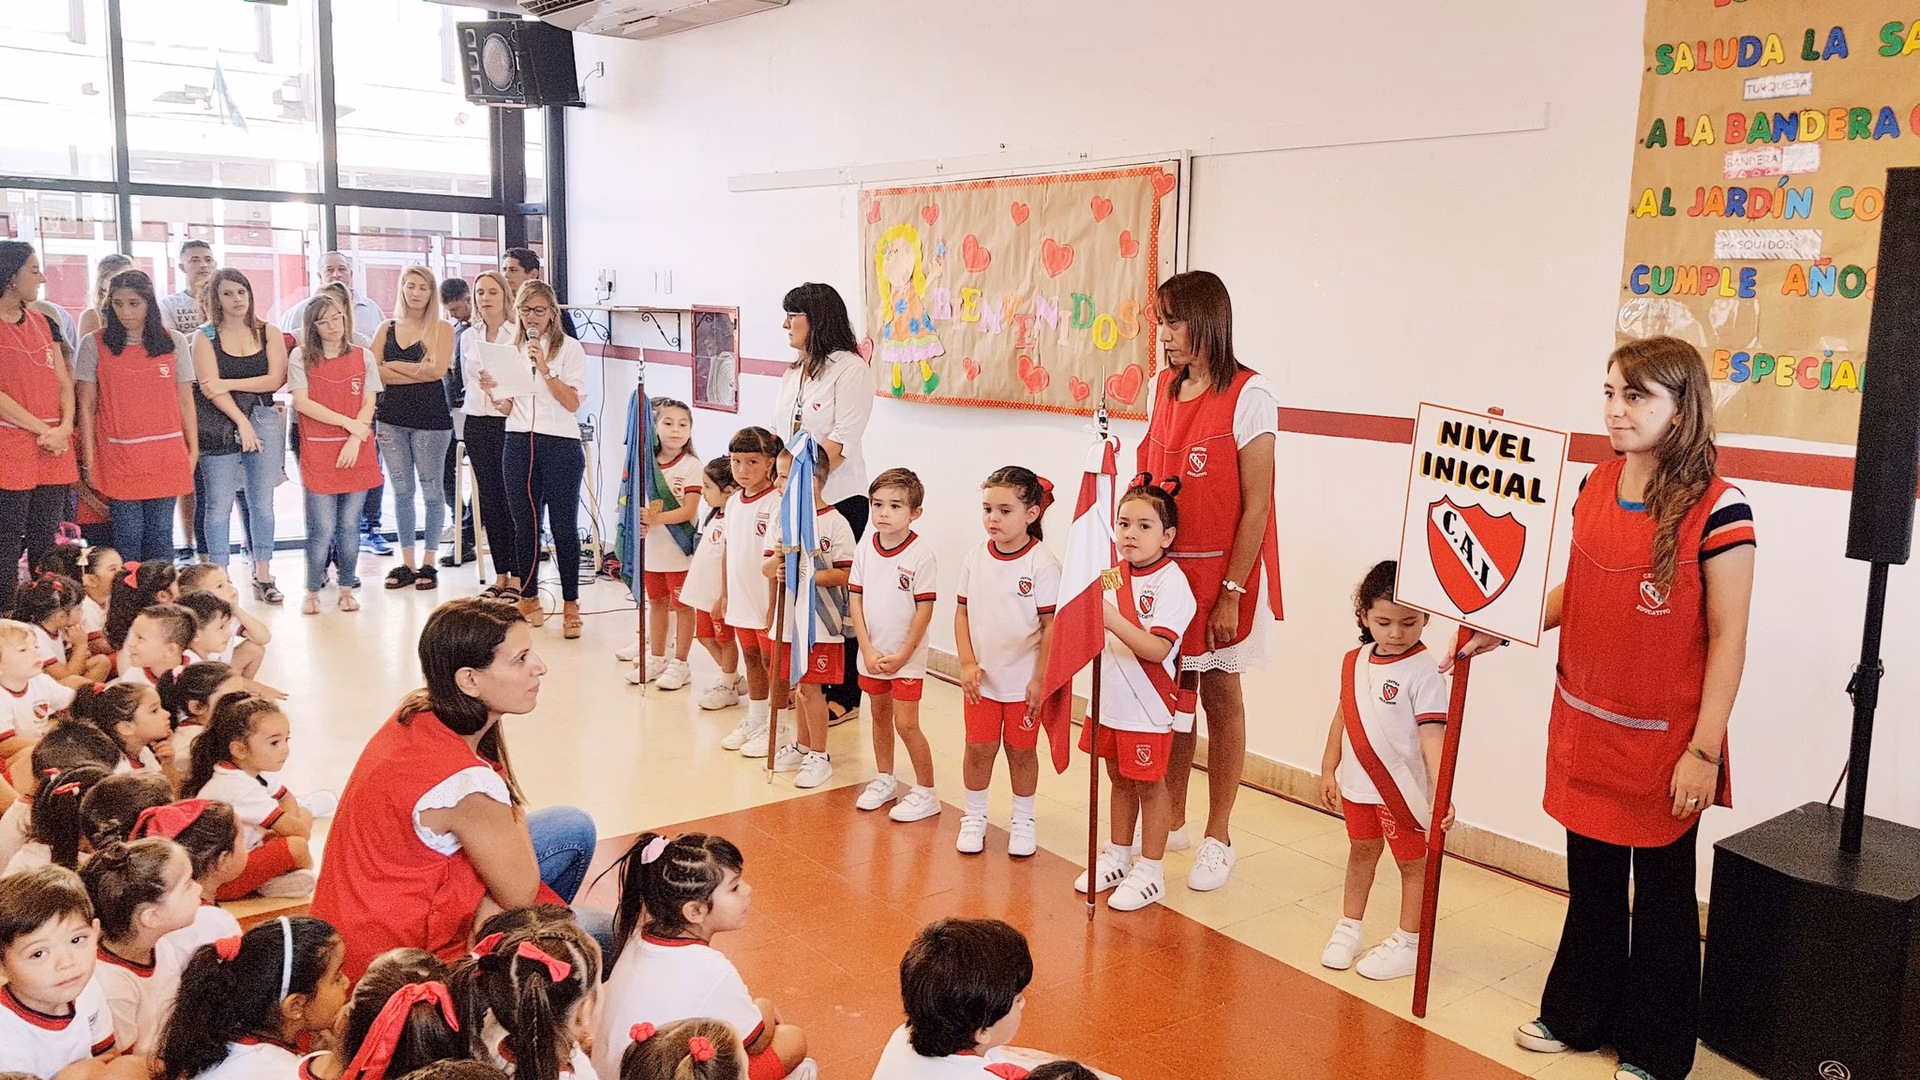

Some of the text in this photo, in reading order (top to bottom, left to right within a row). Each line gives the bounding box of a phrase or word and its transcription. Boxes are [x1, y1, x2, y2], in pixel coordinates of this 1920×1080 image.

[1655, 33, 1785, 75] SALUDA
[1801, 26, 1849, 61] LA
[1746, 78, 1808, 94] TURQUESA
[1645, 118, 1668, 149] A
[1674, 114, 1715, 147] LA
[1725, 106, 1900, 145] BANDERA
[1636, 187, 1676, 219] AL
[1687, 175, 1814, 220] JARDÍN
[1629, 264, 1757, 299] CUMPLE
[933, 287, 1140, 351] BIENVENIDOS
[1711, 349, 1866, 393] ESPECIA
[1437, 420, 1535, 465] NIVEL
[1419, 451, 1546, 506] INICIAL
